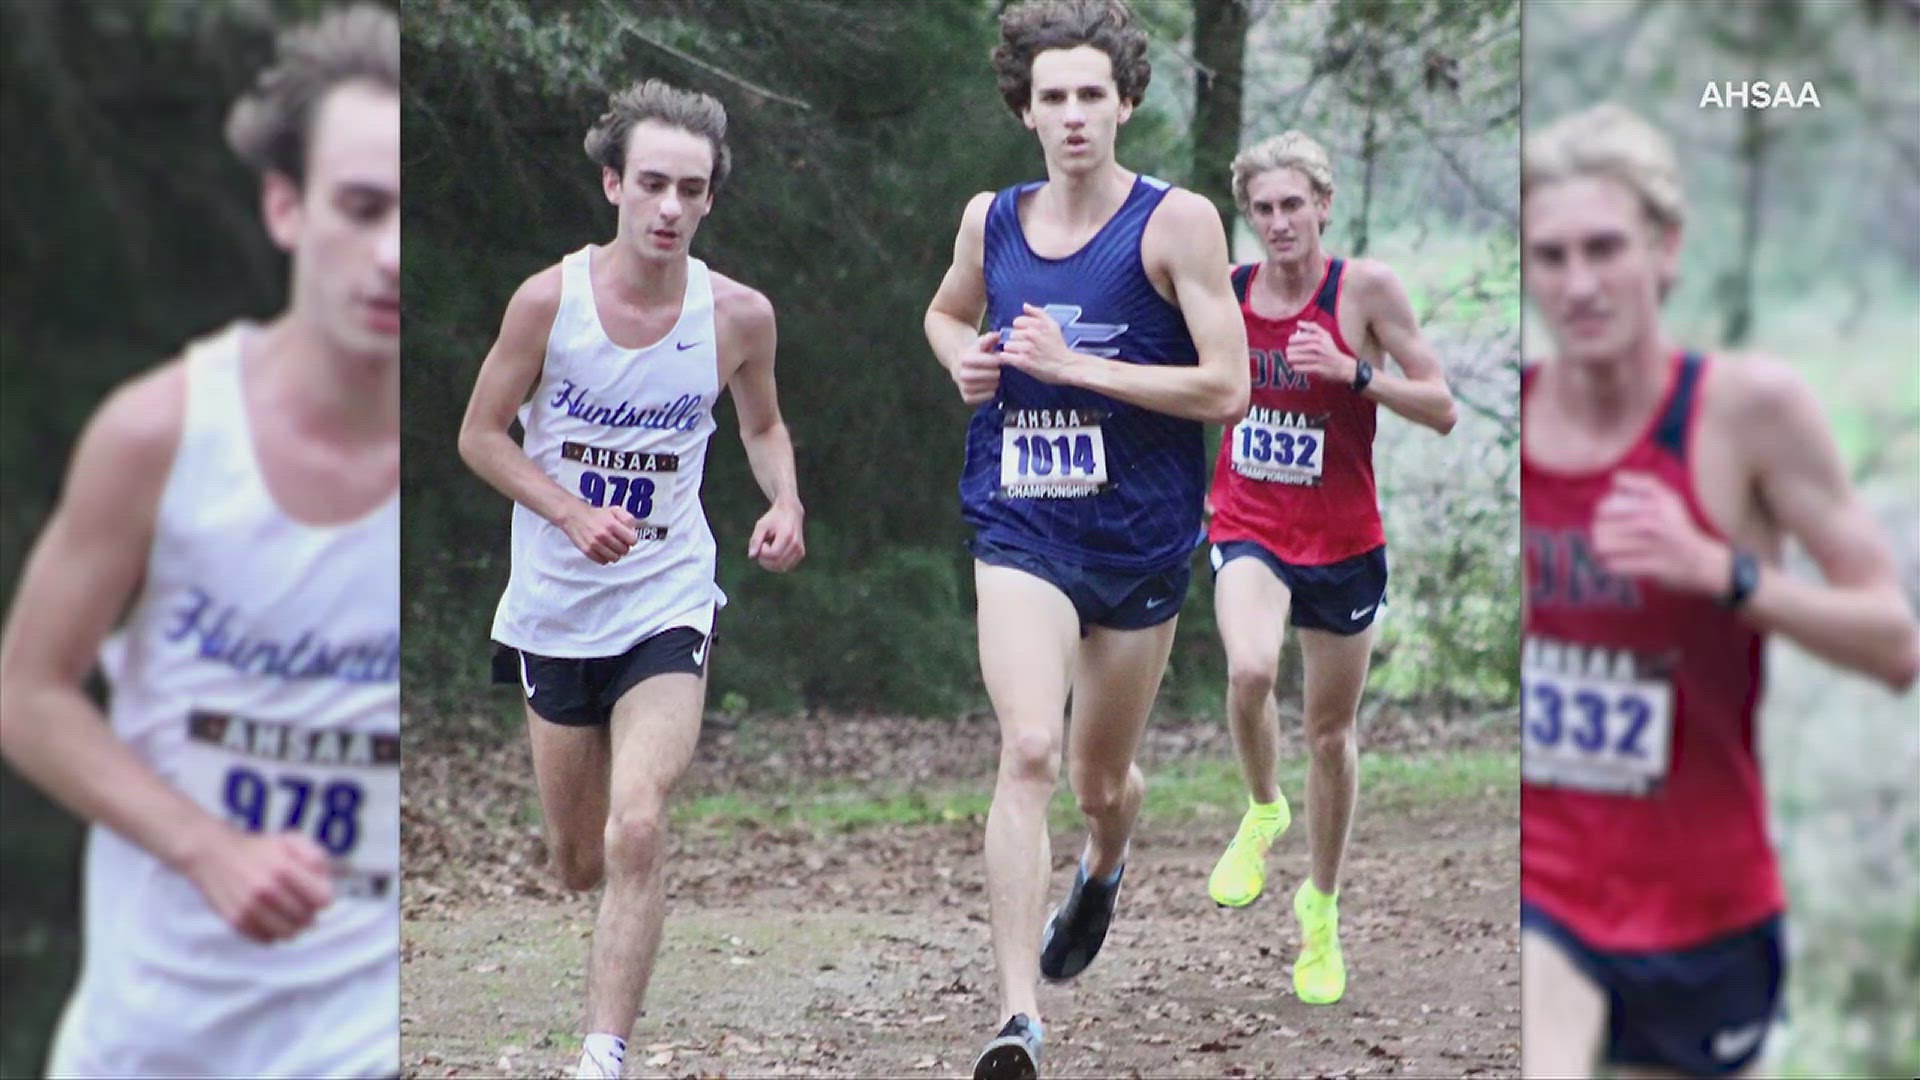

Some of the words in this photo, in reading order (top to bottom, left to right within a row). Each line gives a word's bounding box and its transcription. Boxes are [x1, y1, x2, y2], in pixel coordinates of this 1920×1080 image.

[551, 379, 702, 431] Huntsville
[1017, 409, 1081, 428] AHSAA
[1248, 404, 1308, 430] AHSAA
[580, 447, 658, 472] AHSAA
[1012, 434, 1096, 476] 1014
[1240, 426, 1318, 469] 1332
[579, 471, 656, 519] 978
[1008, 483, 1100, 498] CHAMPIONSHIPS
[1521, 680, 1652, 760] 332
[222, 766, 366, 857] 978
